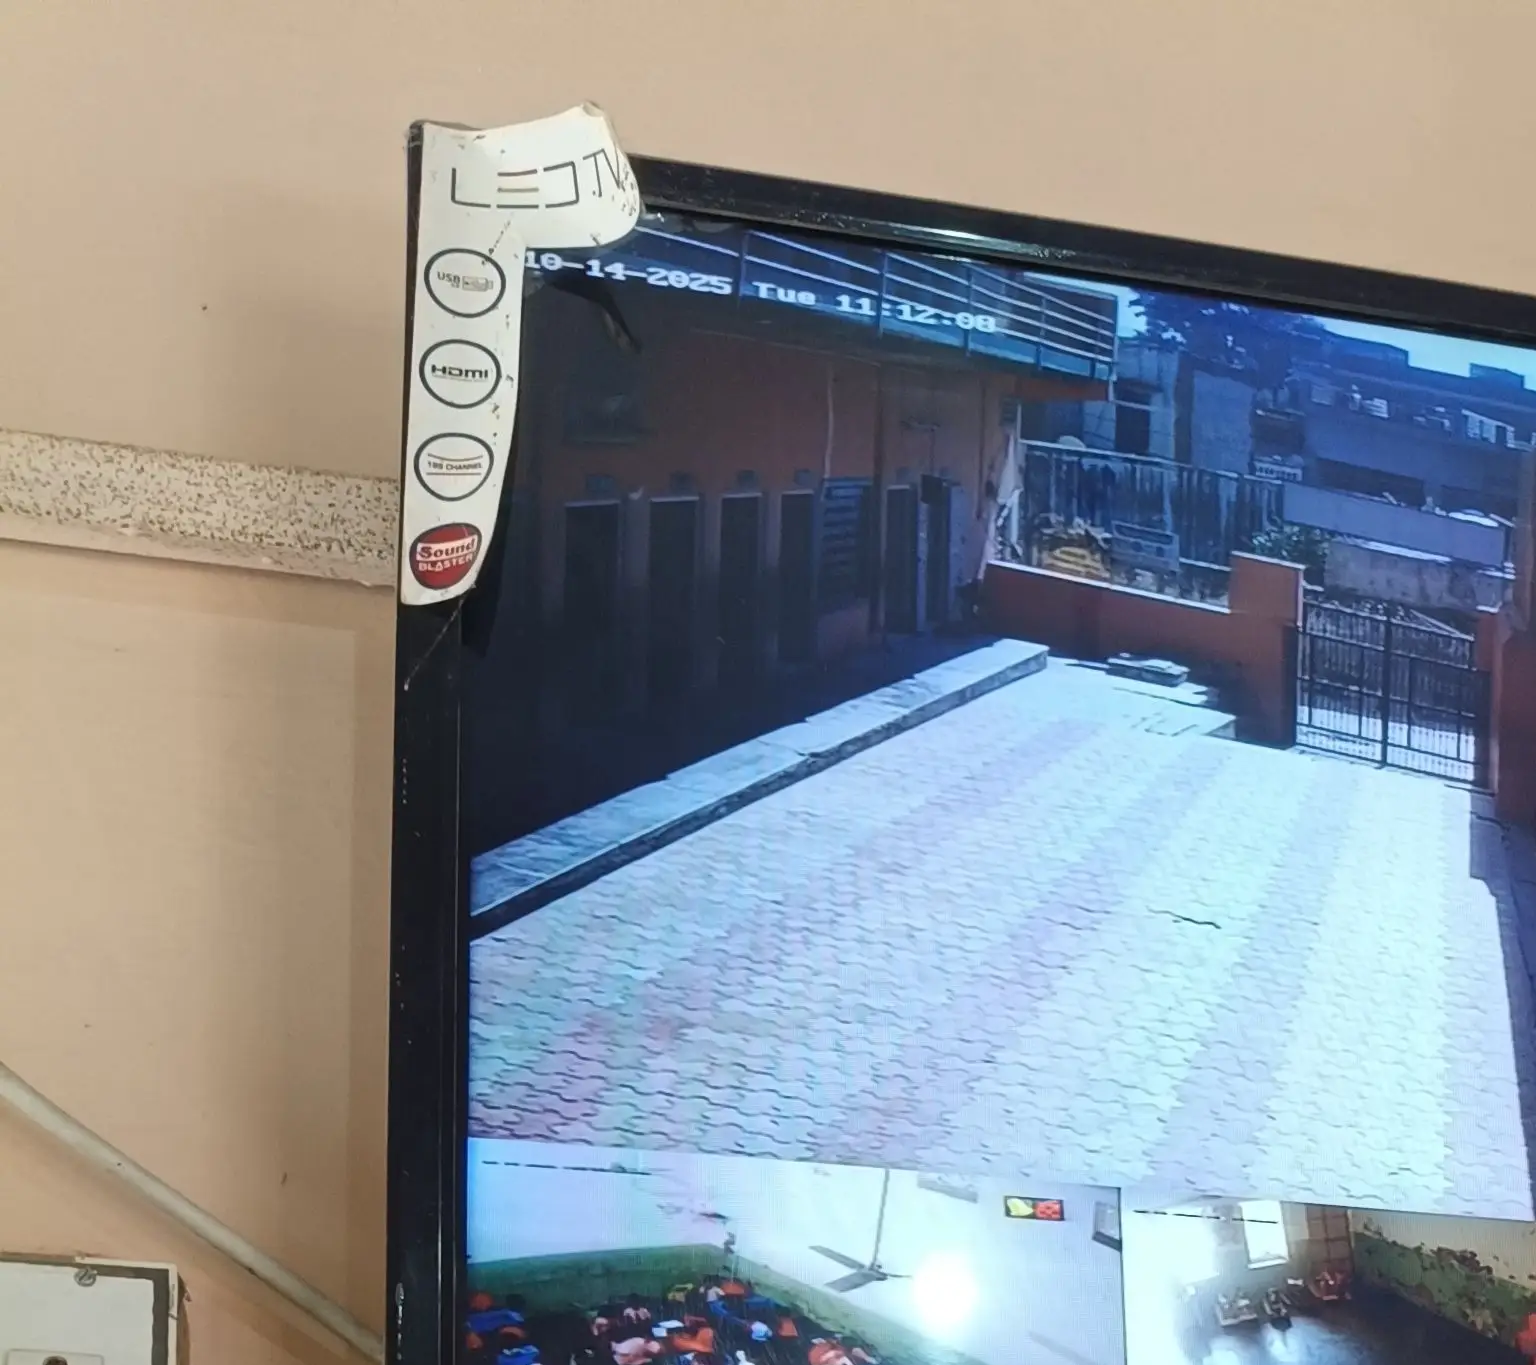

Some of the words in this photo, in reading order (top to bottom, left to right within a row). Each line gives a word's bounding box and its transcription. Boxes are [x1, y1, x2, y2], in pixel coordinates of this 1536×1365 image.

[525, 250, 733, 295] 10-14-2025
[752, 280, 816, 305] Tue
[419, 538, 475, 558] Sound
[418, 553, 473, 572] BLASTER
